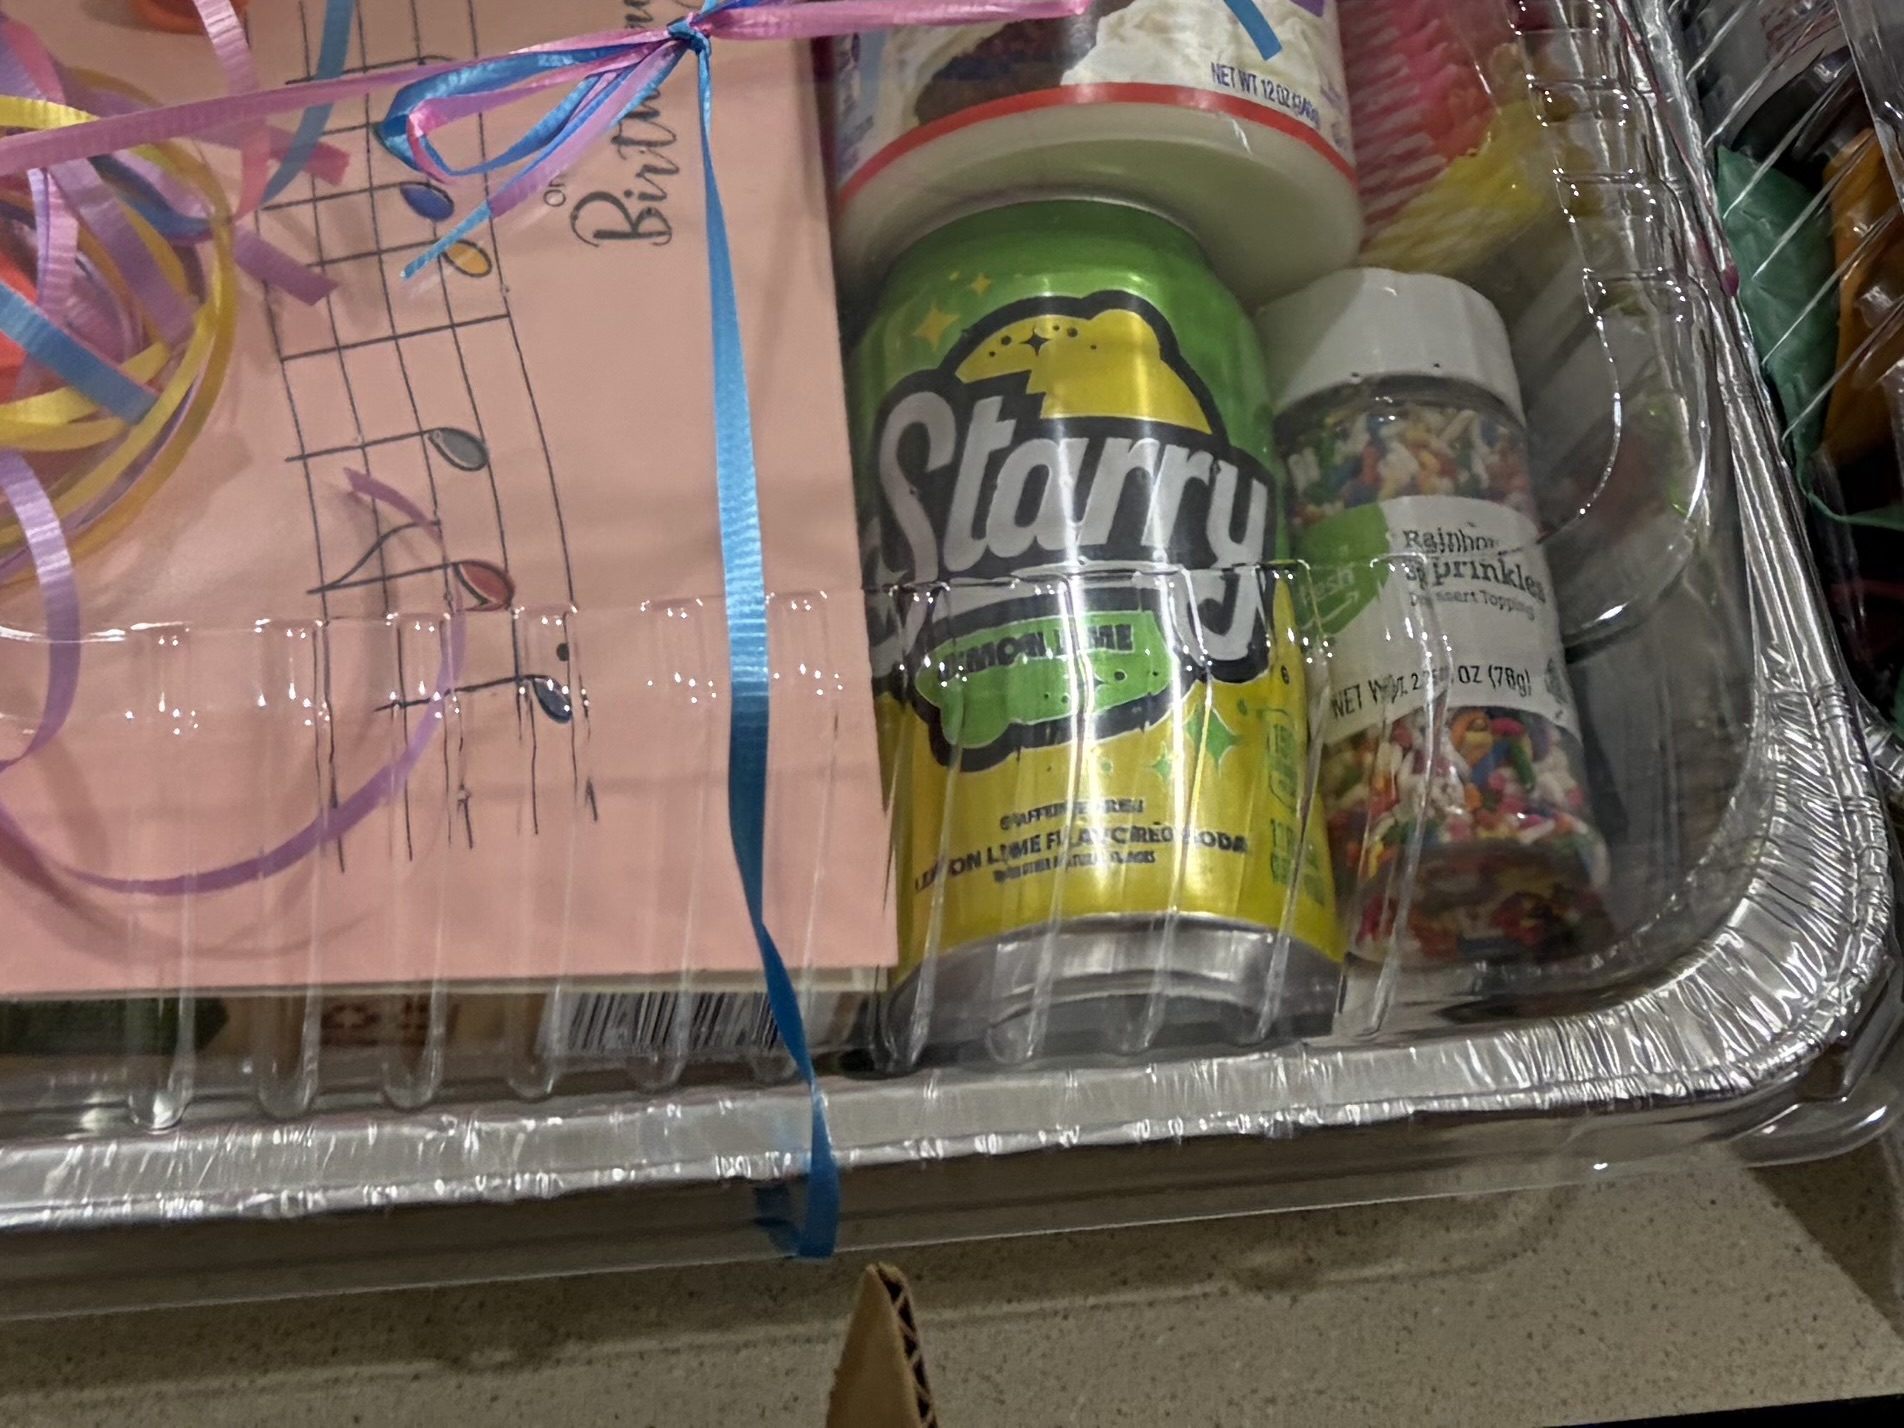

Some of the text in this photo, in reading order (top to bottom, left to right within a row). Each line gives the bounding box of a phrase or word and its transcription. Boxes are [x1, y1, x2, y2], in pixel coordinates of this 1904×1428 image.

[1210, 61, 1235, 88] NET
[1238, 68, 1258, 94] WT
[1261, 79, 1276, 102] 12
[864, 383, 1271, 661] Starry
[1479, 588, 1536, 621] Topping
[1053, 624, 1135, 654] LME
[1330, 682, 1363, 719] NET
[1458, 665, 1483, 685] OZ
